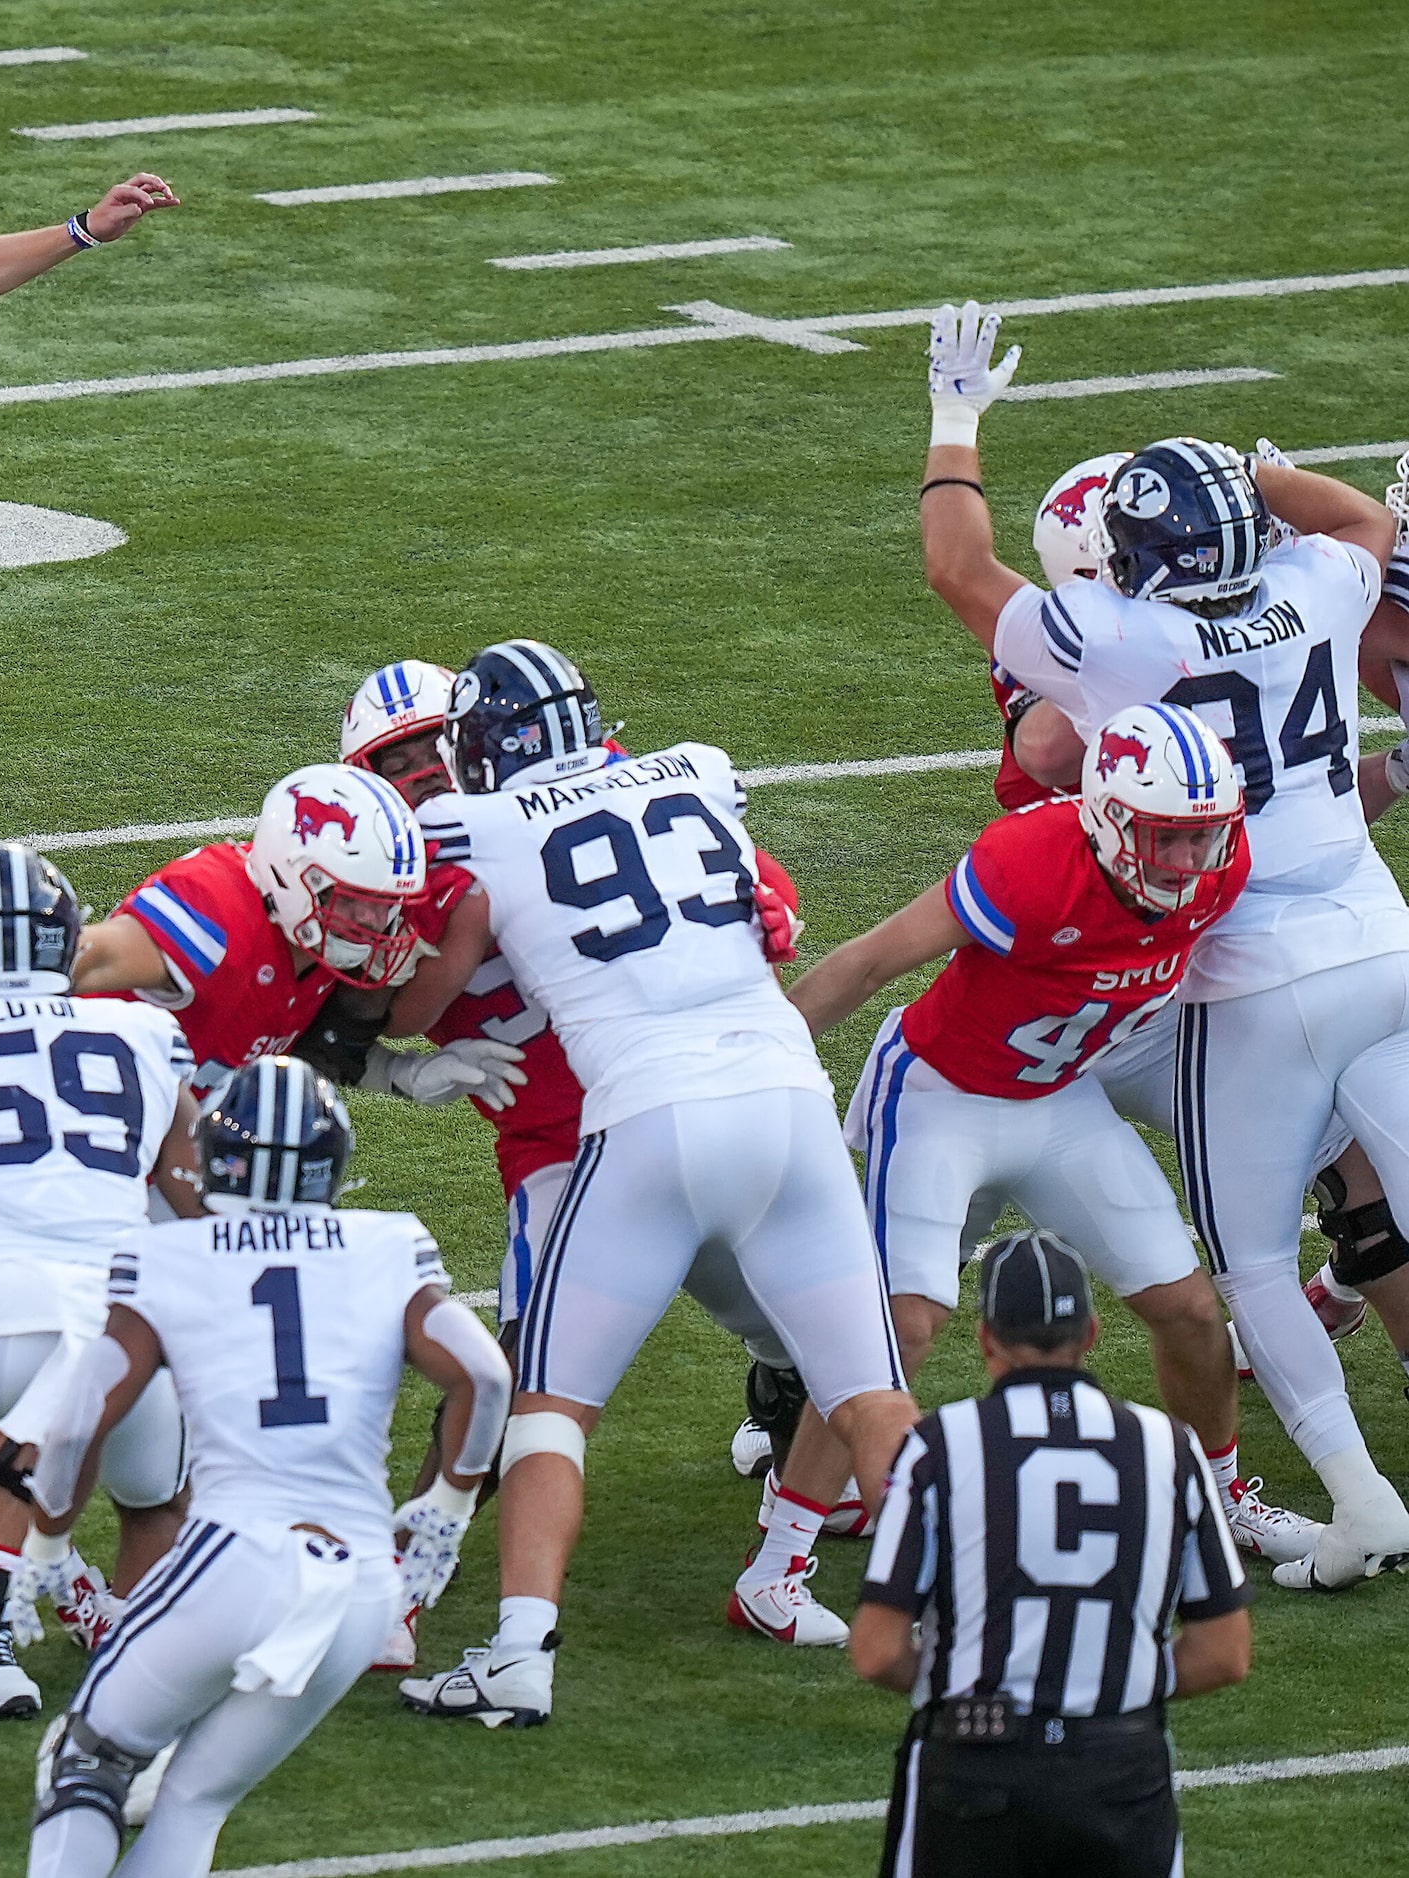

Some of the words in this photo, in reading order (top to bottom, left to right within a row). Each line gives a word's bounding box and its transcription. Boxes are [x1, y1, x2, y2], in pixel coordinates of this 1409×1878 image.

[1127, 473, 1162, 511] Y
[1195, 600, 1306, 660] NELSON
[1159, 638, 1355, 817] 94
[1192, 802, 1216, 813] SMU
[540, 793, 755, 963] 93
[1092, 952, 1180, 991] SMU
[213, 1214, 345, 1251] HARPER
[252, 1266, 329, 1429] 1
[1016, 1446, 1120, 1588] C
